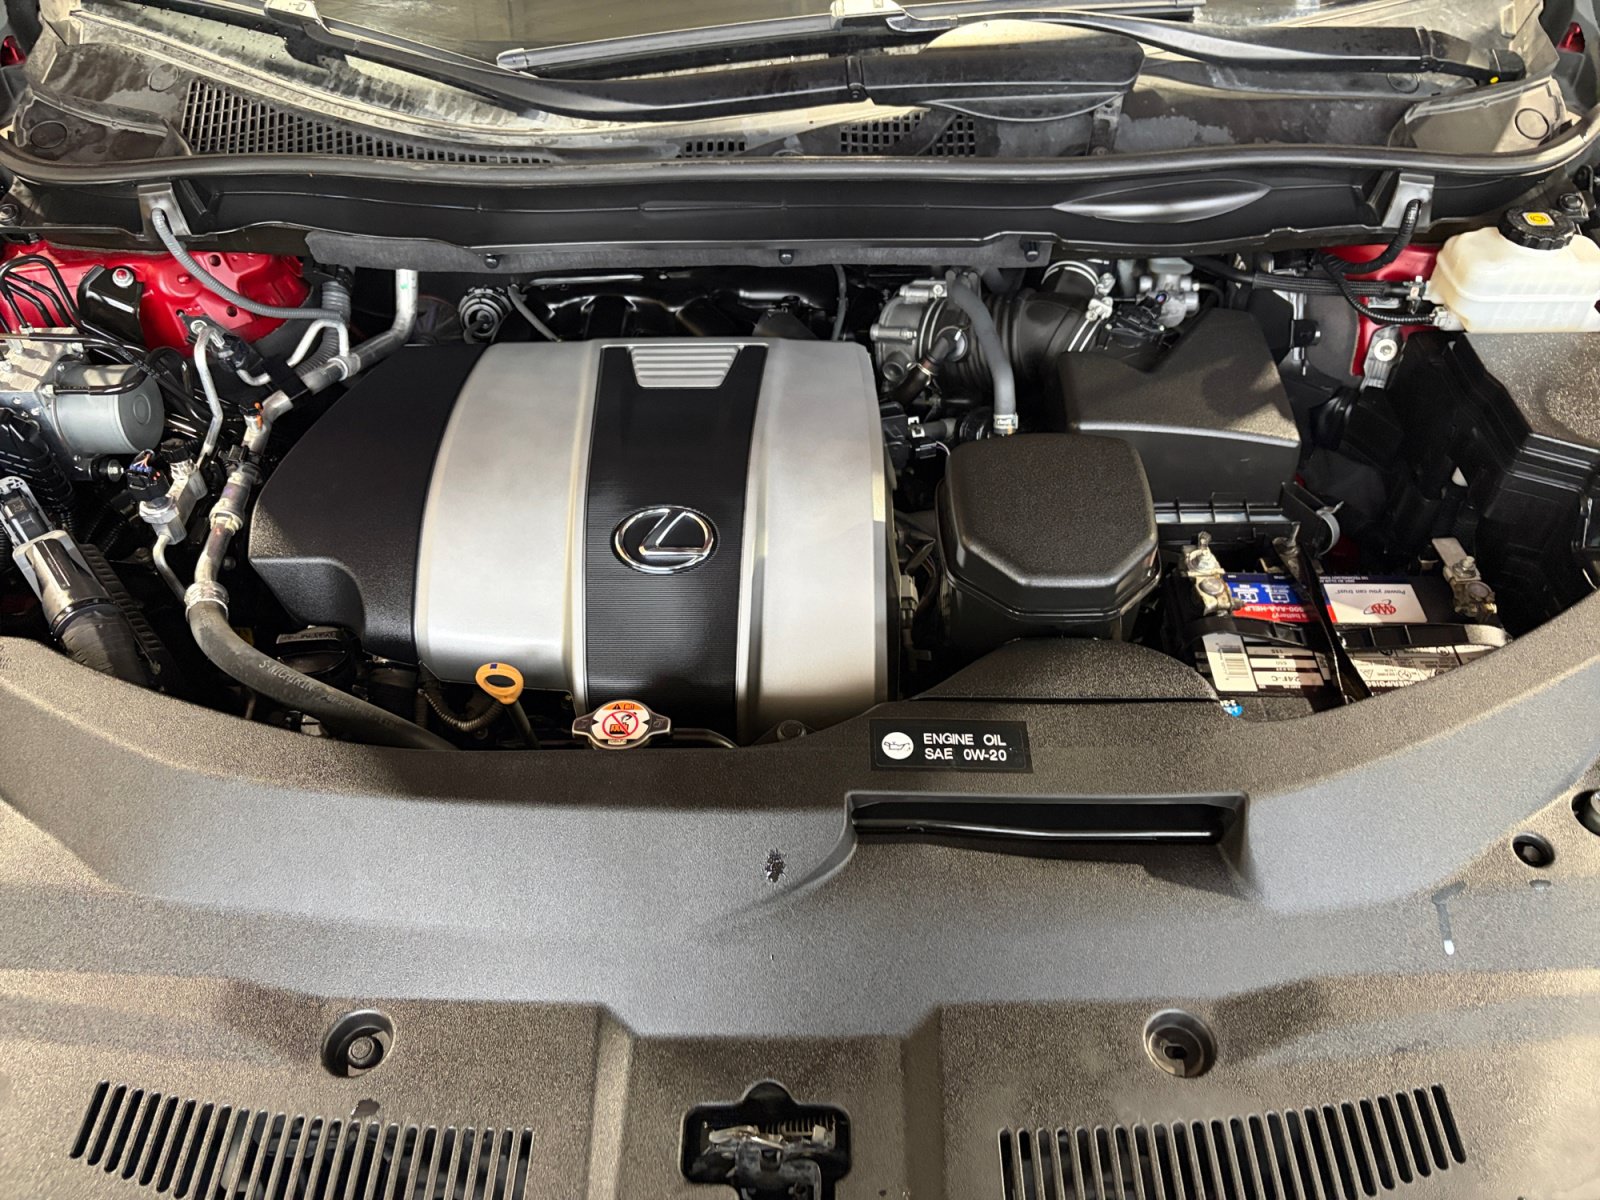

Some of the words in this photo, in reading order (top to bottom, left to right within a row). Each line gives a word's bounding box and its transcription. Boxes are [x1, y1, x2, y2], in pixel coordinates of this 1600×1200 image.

[923, 732, 974, 746] ENGINE
[983, 733, 1007, 746] OIL
[924, 748, 953, 760] SAE
[963, 749, 1007, 761] 0W-20
